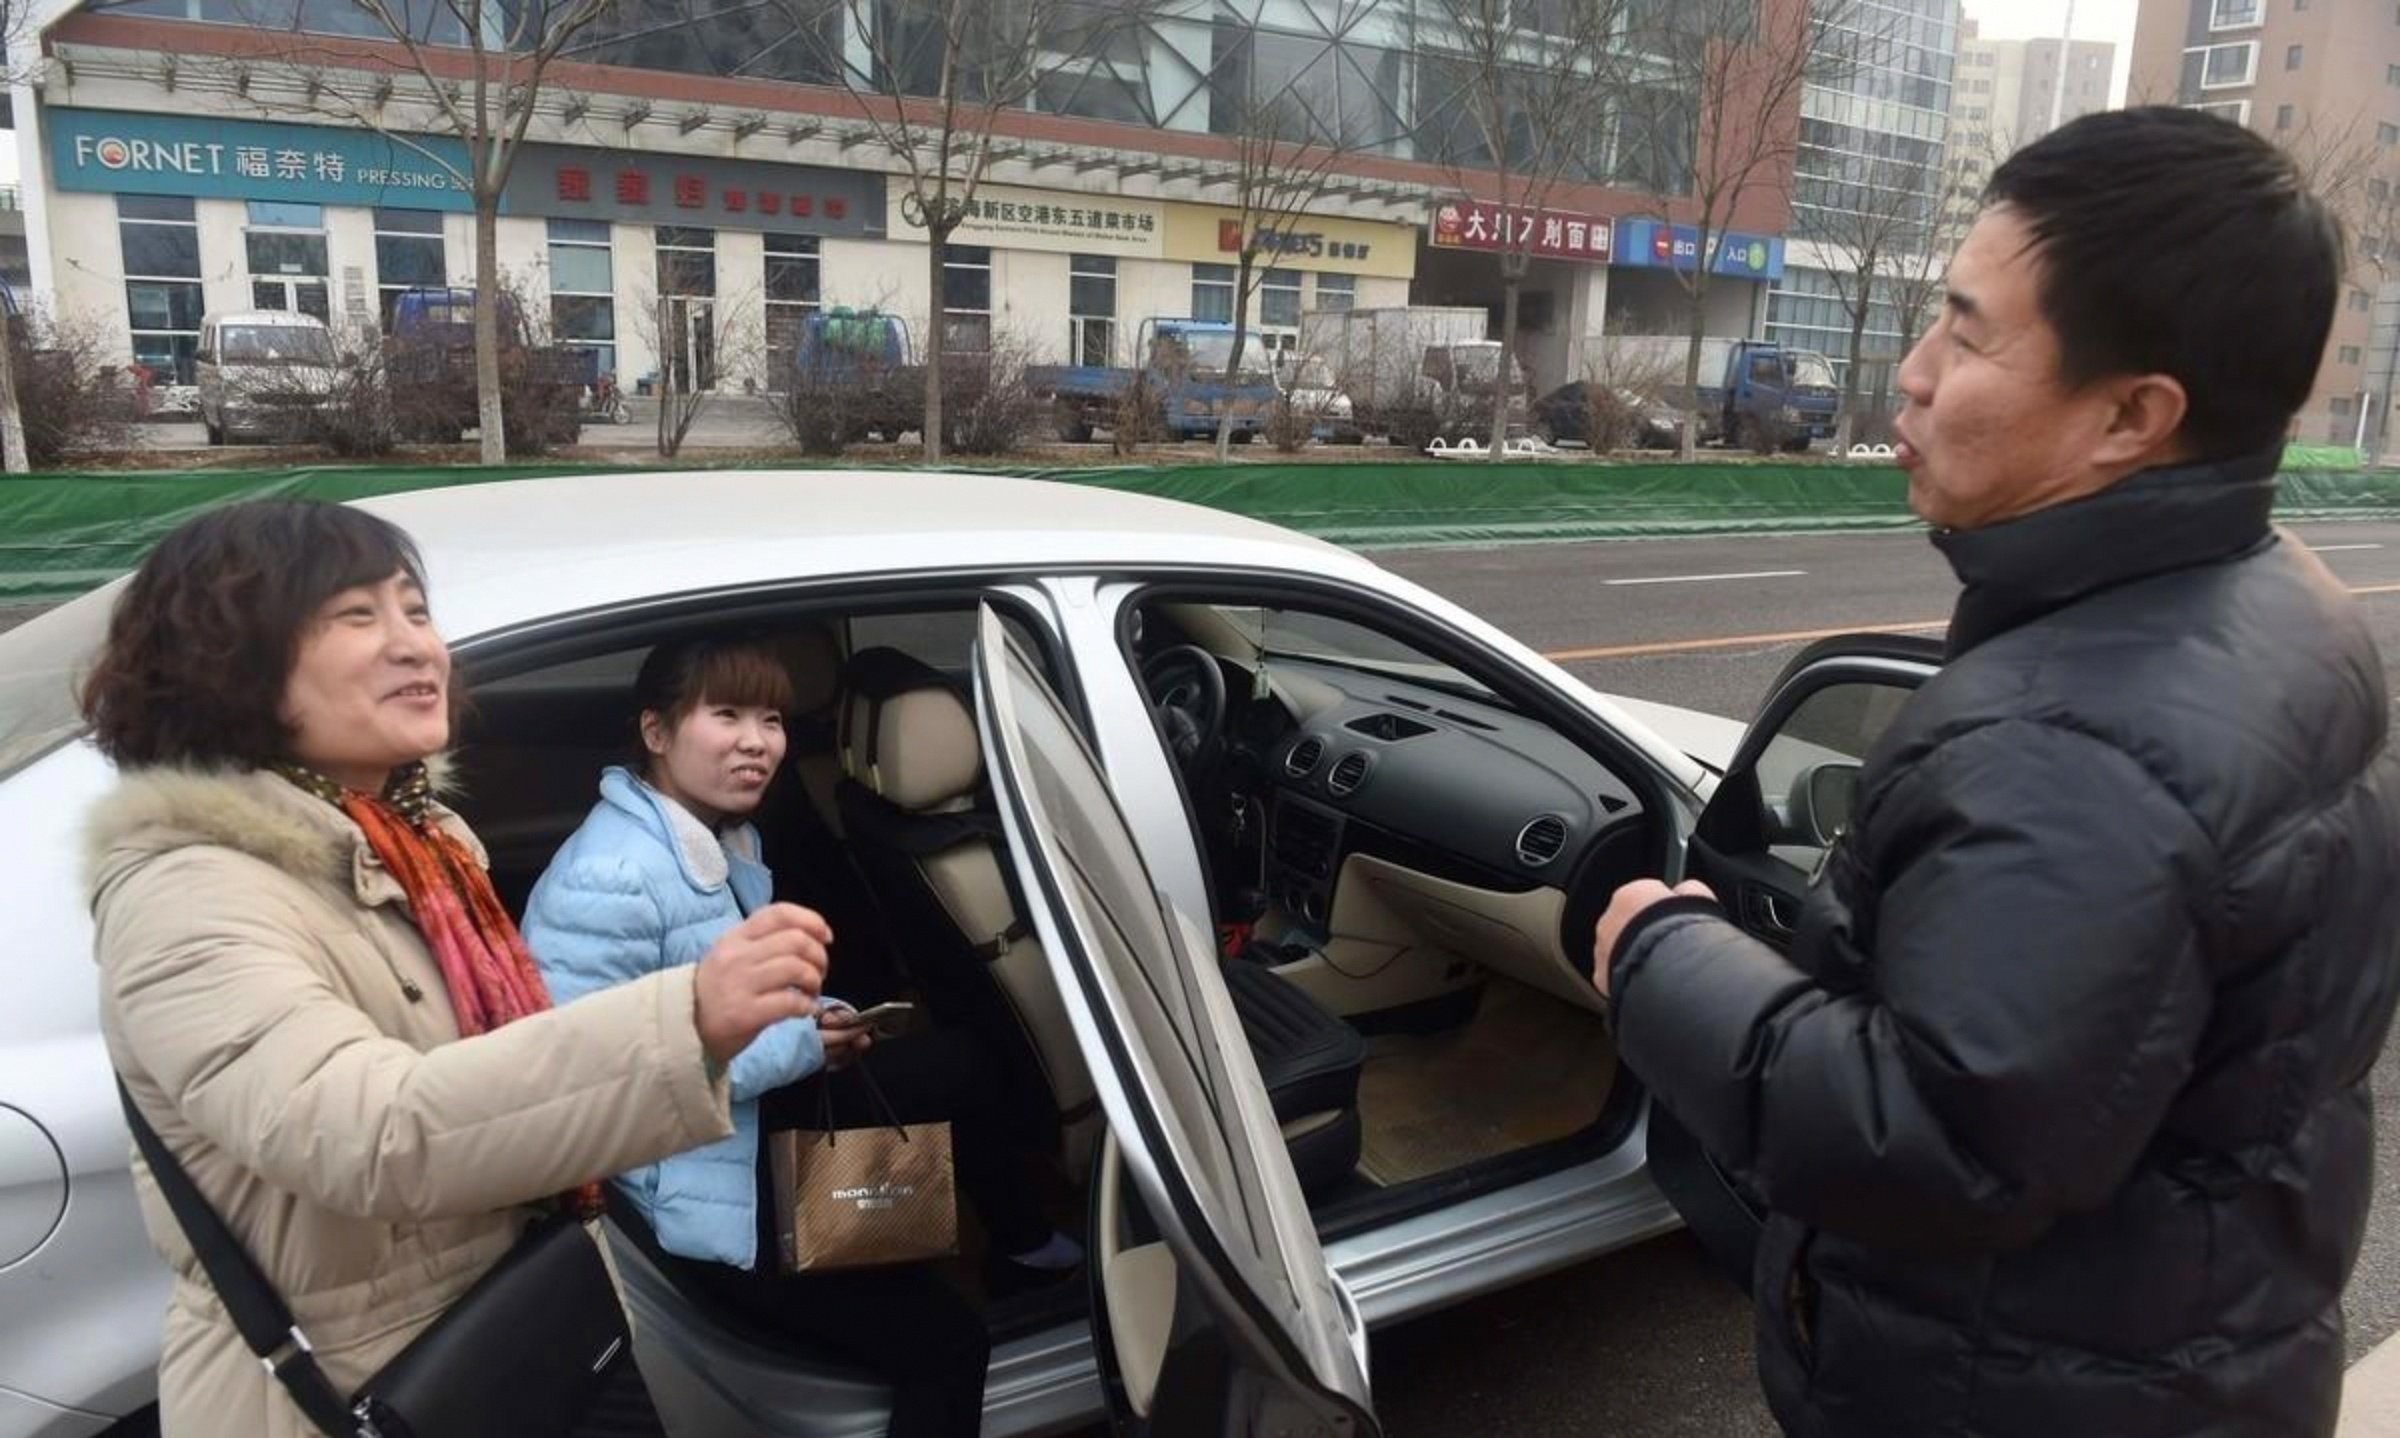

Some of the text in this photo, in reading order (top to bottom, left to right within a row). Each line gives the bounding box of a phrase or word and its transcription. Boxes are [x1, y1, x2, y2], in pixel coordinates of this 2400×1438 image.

[75, 134, 446, 190] FORNET 福奈特 PRESSING
[1727, 246, 1747, 262] 入口
